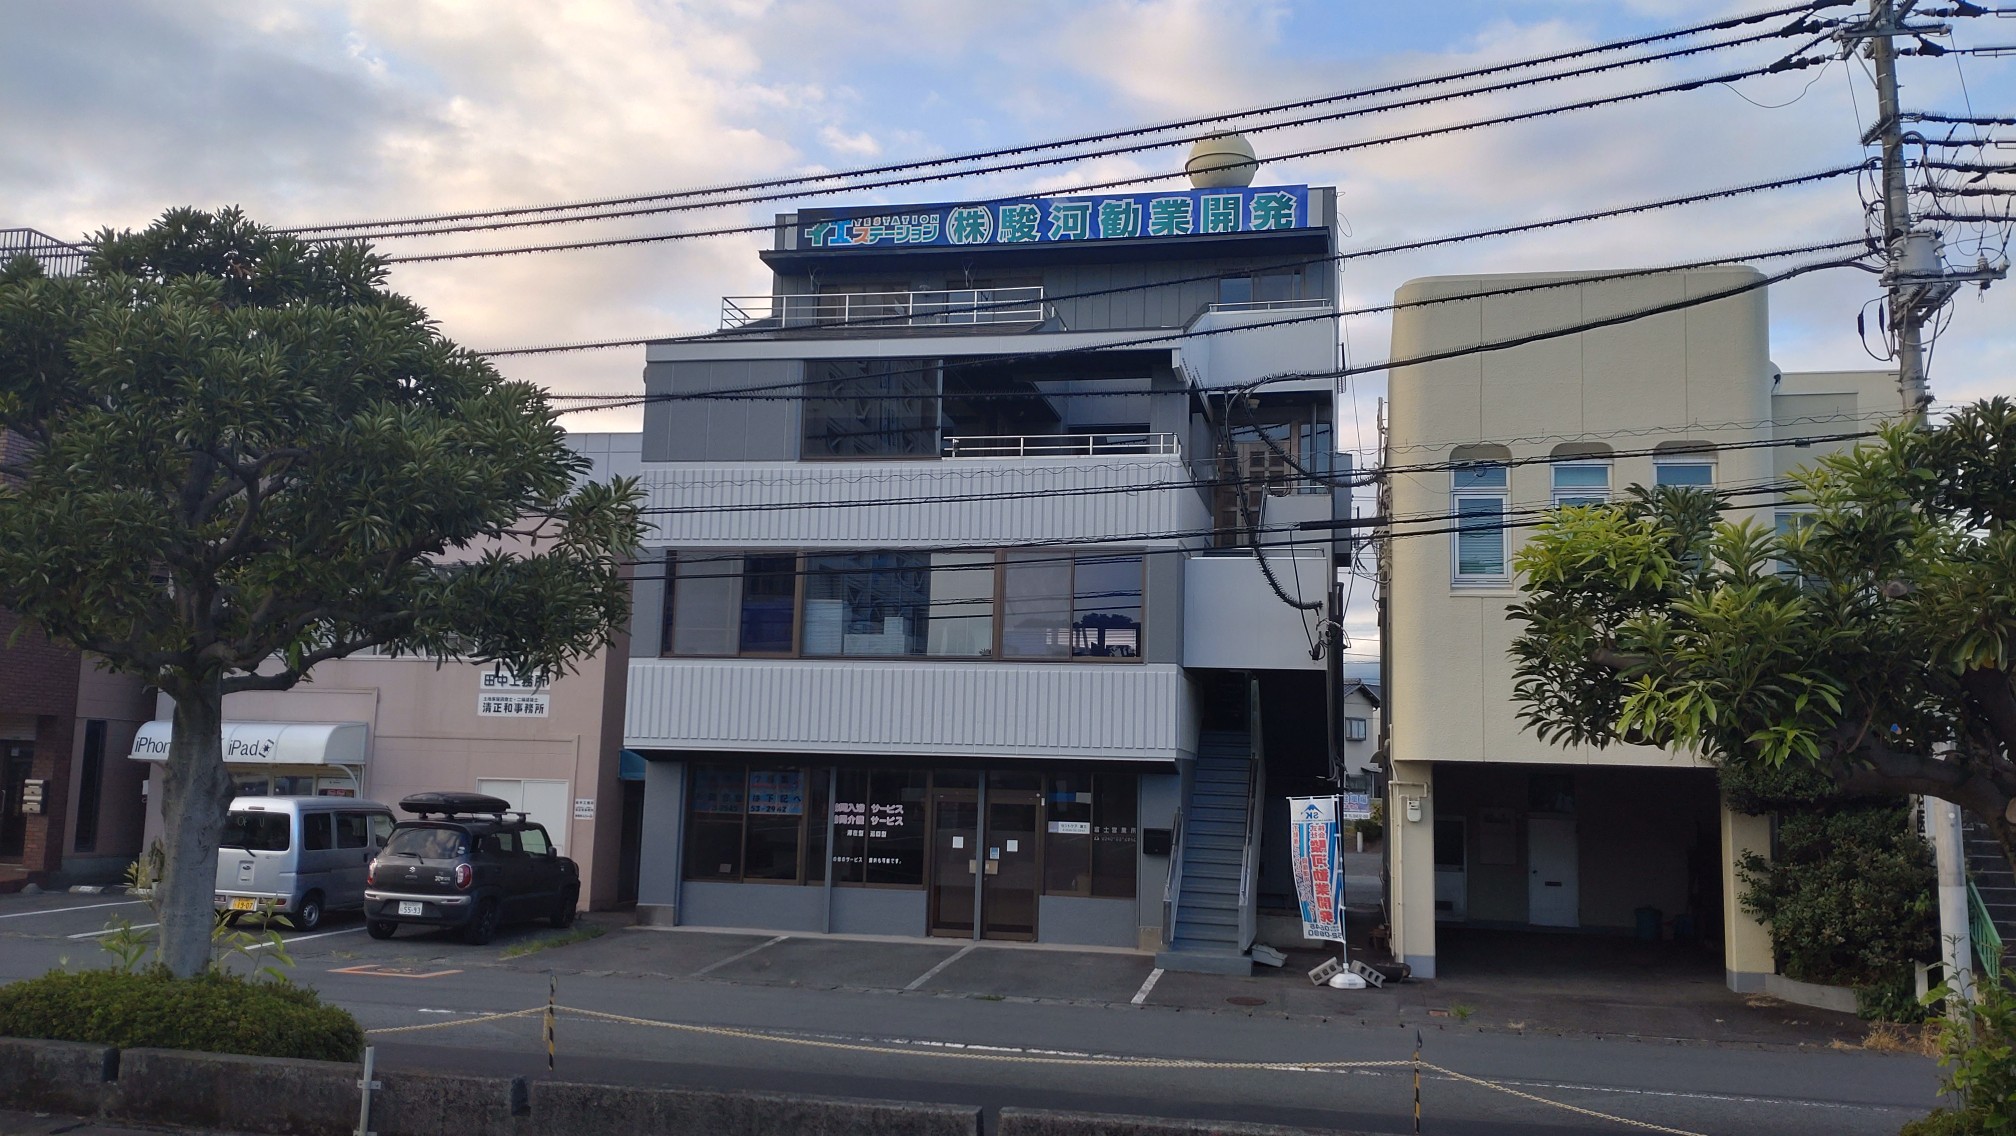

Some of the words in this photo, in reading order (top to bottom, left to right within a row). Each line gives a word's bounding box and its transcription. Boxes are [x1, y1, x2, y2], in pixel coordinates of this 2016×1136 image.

[804, 218, 940, 247] イエステーション
[134, 737, 171, 753] iPhon
[228, 739, 260, 756] iPad
[870, 803, 904, 814] サービス
[870, 815, 904, 826] サービス
